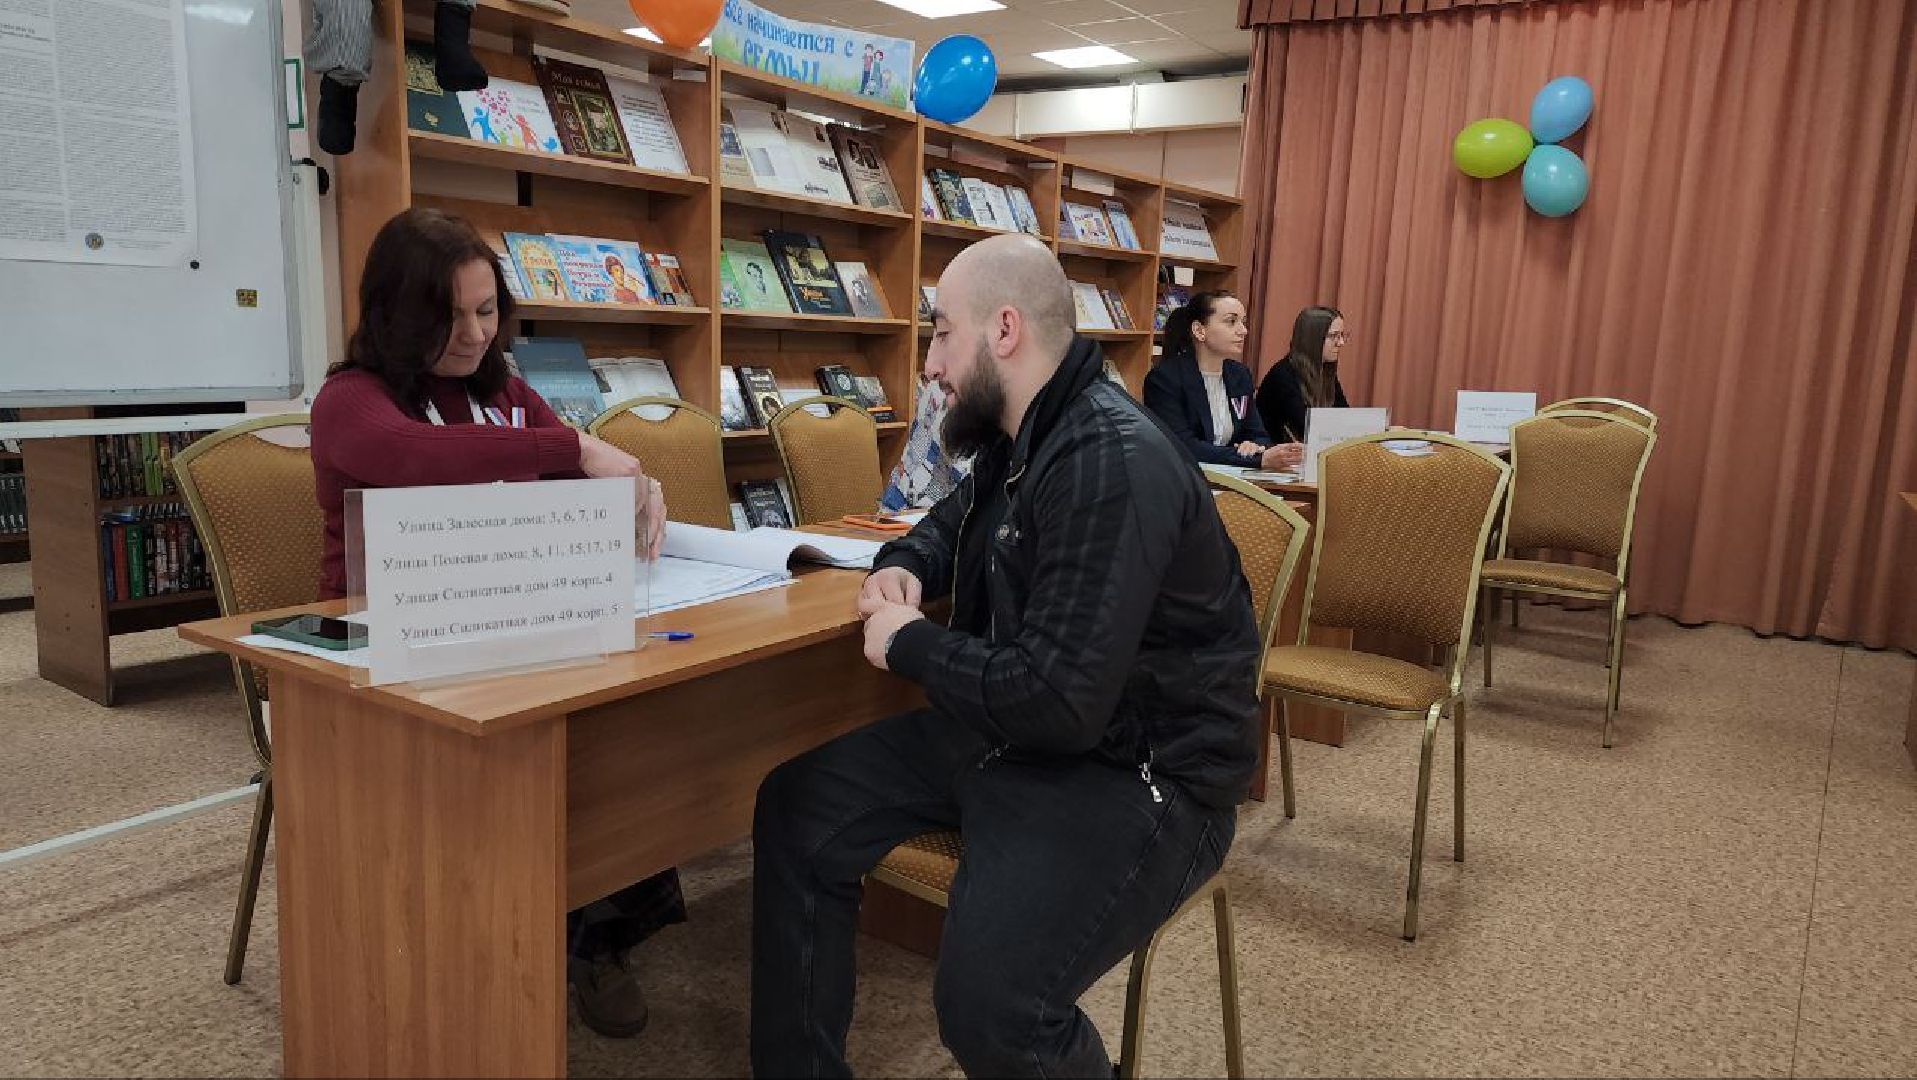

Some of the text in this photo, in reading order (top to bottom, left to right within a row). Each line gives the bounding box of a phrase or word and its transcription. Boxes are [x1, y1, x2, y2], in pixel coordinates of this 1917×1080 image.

[747, 12, 835, 54] начинается
[398, 520, 443, 534] Улица
[383, 558, 427, 572] Улица
[395, 592, 439, 606] Улица
[443, 585, 521, 601] Силикатная
[525, 581, 549, 594] дом
[605, 572, 612, 582] 4
[401, 627, 445, 641] Улица
[449, 617, 528, 634] Силикатная
[531, 614, 554, 626] дом
